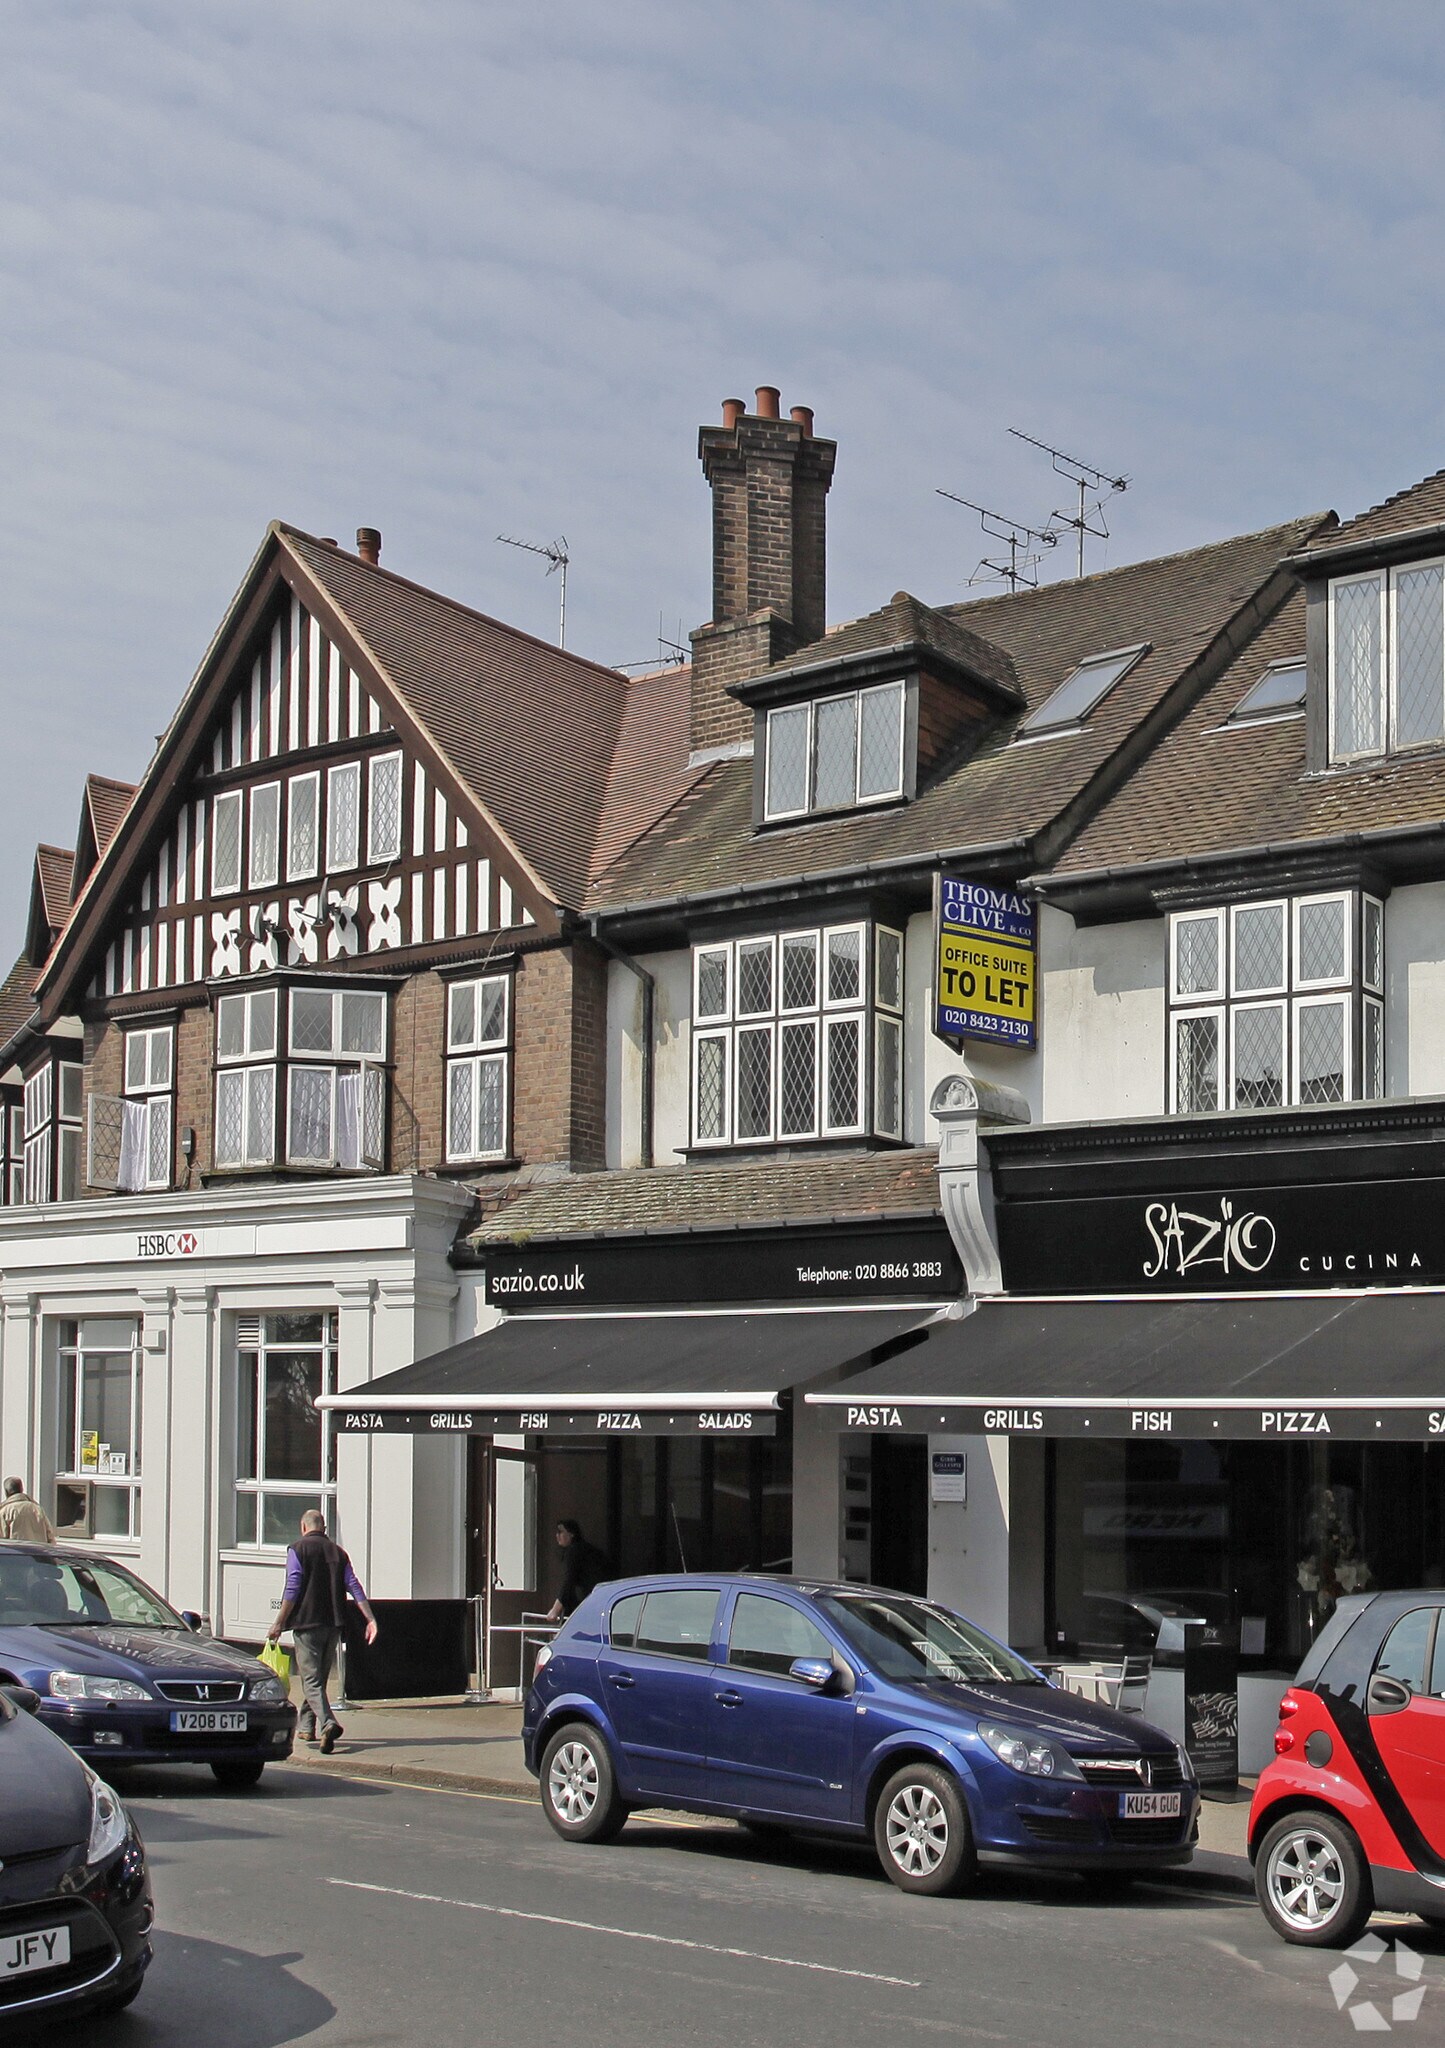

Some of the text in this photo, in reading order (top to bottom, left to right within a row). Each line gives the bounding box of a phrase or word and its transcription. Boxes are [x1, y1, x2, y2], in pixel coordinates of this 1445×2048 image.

[943, 880, 1032, 916] THOMAS
[944, 901, 1006, 931] CLIVE
[1009, 924, 1017, 934] &
[1019, 926, 1032, 937] CO
[945, 947, 1028, 976] OFFICE SUITE
[943, 966, 1029, 1008] TO LET
[945, 1009, 967, 1026] 020
[969, 1013, 998, 1031] 8423
[1000, 1019, 1029, 1037] 2130
[137, 1234, 176, 1257] HSBC
[796, 1261, 943, 1285] Telephone: 020 8866 3883
[1299, 1252, 1422, 1272] CUCINA
[491, 1263, 586, 1293] sazio.co.uk
[345, 1412, 752, 1430] PASTA GRILLS FISH PIZZA SALADS
[847, 1406, 903, 1427] PASTA
[983, 1409, 1043, 1430] GRILLS
[1131, 1411, 1172, 1431] FISH
[1261, 1411, 1332, 1433] PIZZA
[180, 1714, 245, 1729] V208 GTP
[1127, 1795, 1179, 1814] KU54 GUG
[6, 1932, 57, 1969] JFY
